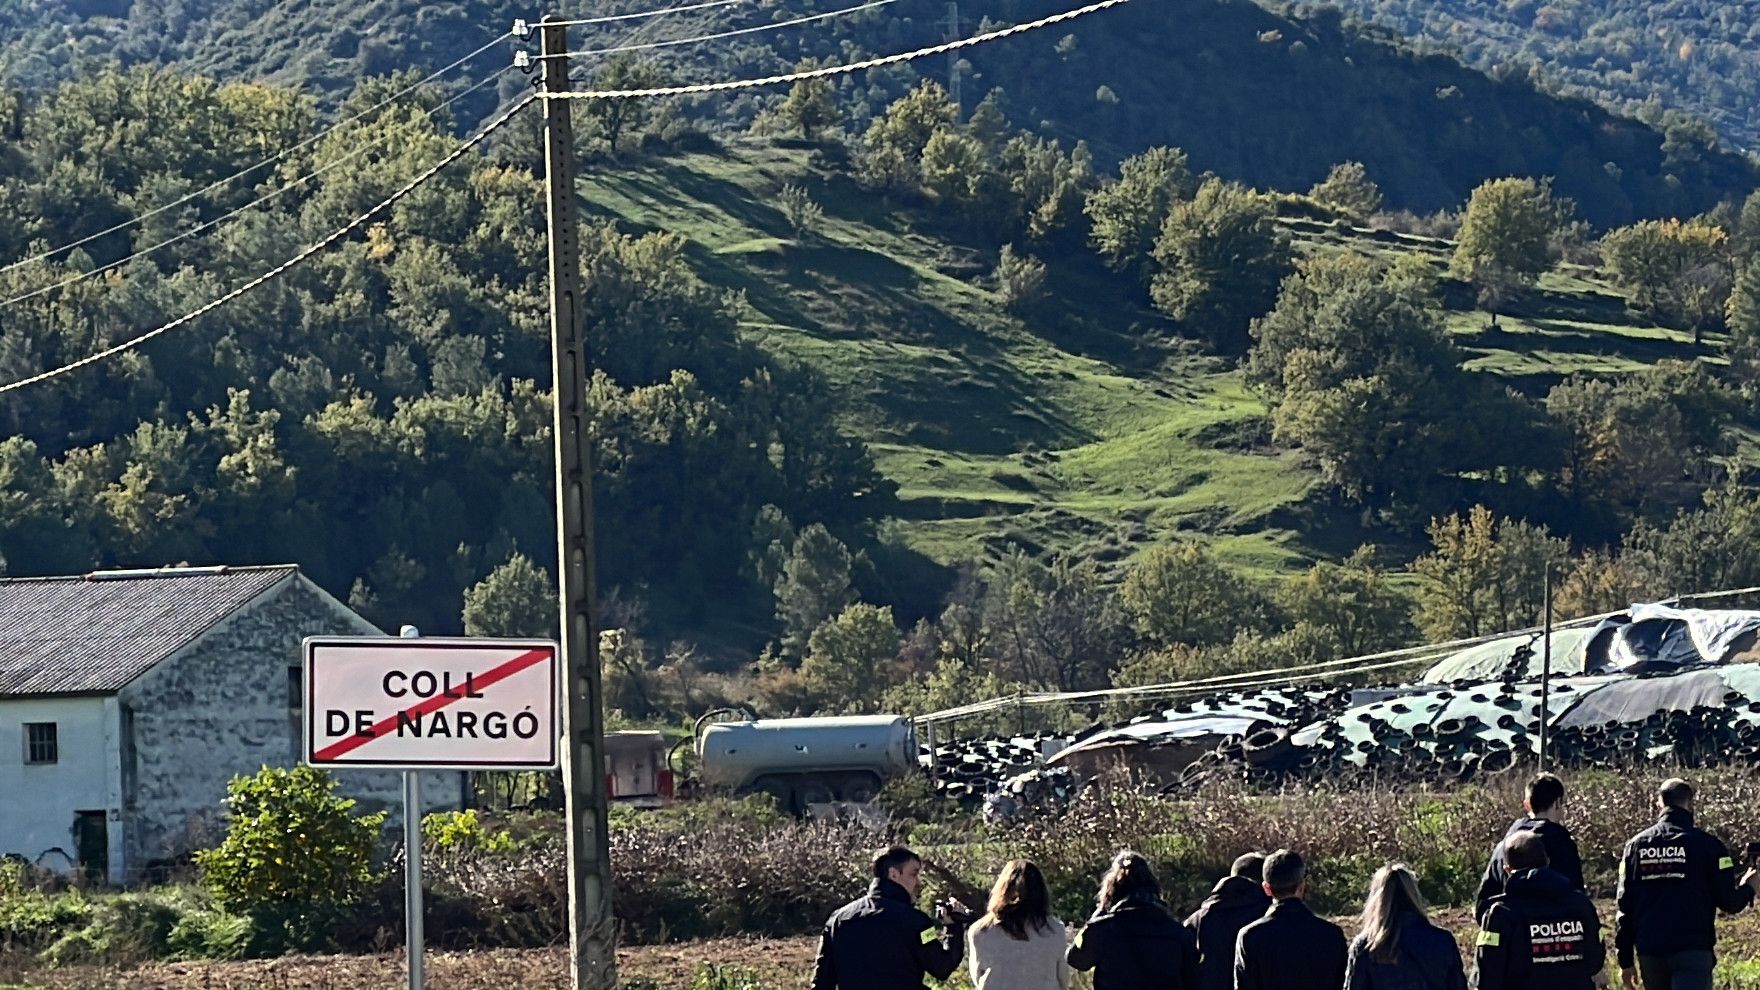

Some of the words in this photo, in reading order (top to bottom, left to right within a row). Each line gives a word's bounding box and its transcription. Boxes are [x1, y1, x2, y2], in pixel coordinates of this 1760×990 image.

[382, 670, 484, 699] COLL
[326, 709, 376, 738] DE
[396, 706, 539, 740] NARGÓ
[1640, 846, 1686, 859] POLICIA
[1530, 920, 1584, 937] POLICIA
